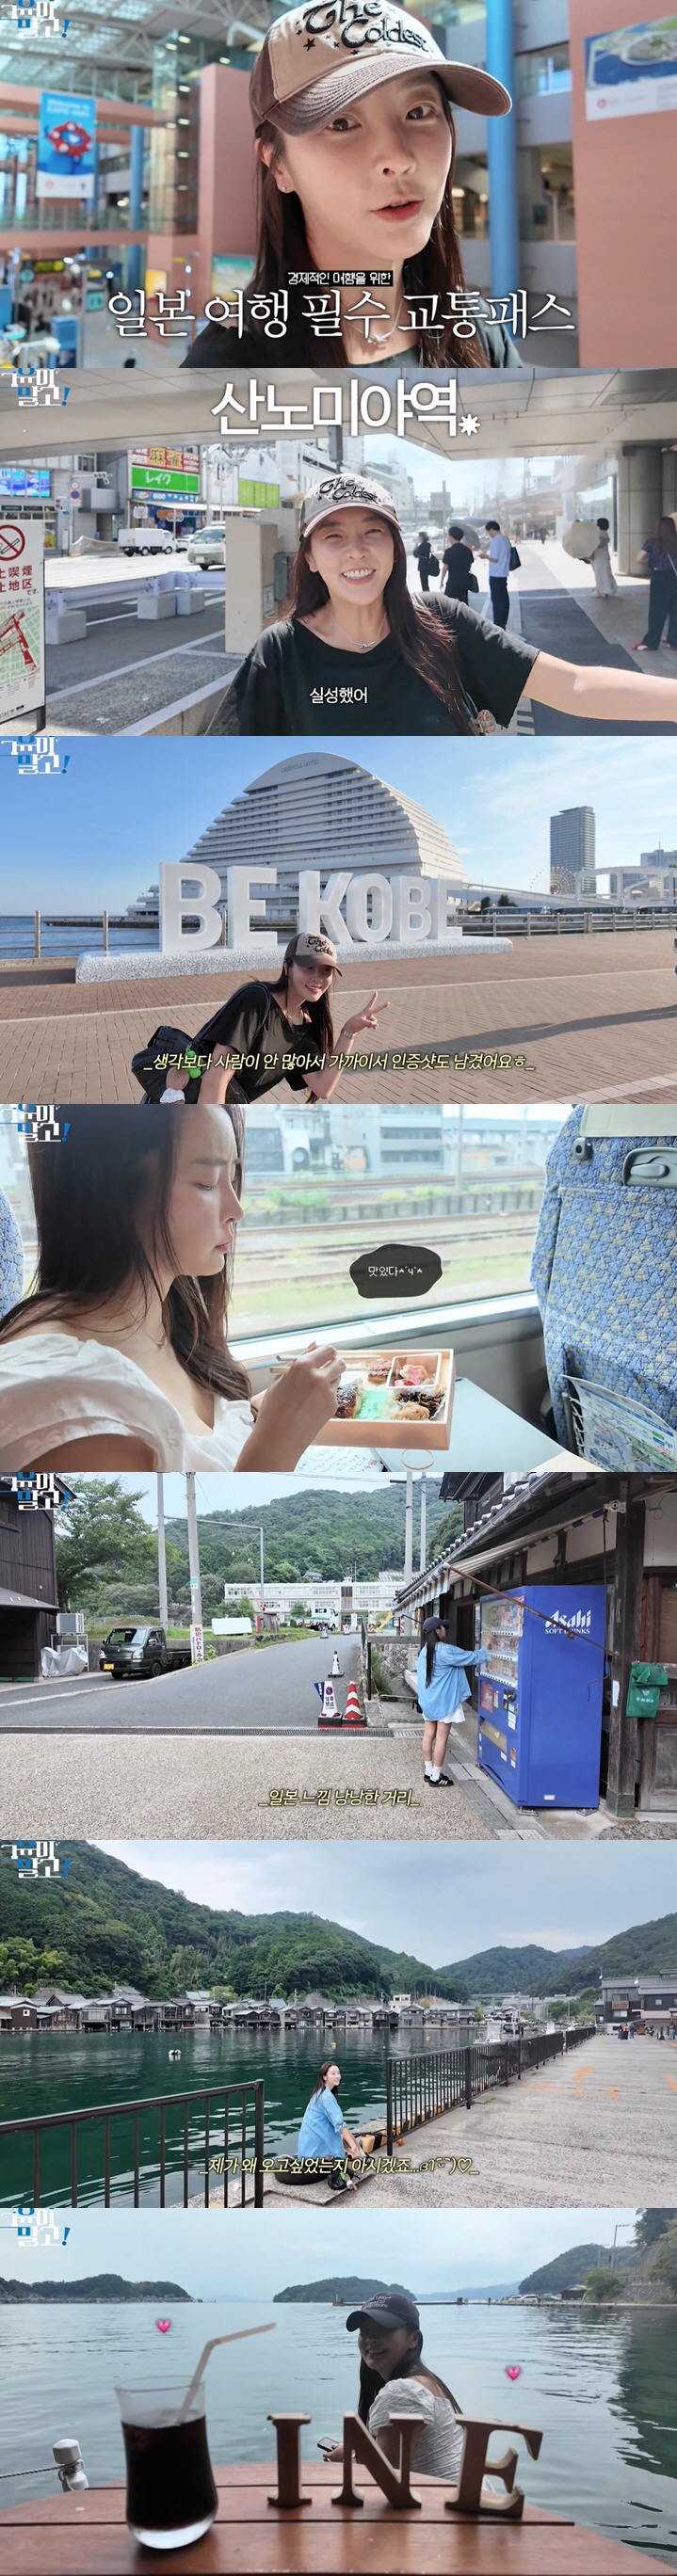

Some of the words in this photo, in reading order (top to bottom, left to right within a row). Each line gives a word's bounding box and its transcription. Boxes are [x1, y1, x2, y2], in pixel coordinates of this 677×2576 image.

[303, 0, 382, 34] The
[149, 449, 182, 468] 麻雀
[145, 471, 171, 486] レイク
[319, 476, 356, 494] The
[159, 861, 278, 952] BE
[298, 870, 463, 943] KOBE
[544, 1609, 591, 1627] Asahi
[266, 2411, 543, 2519] INE
